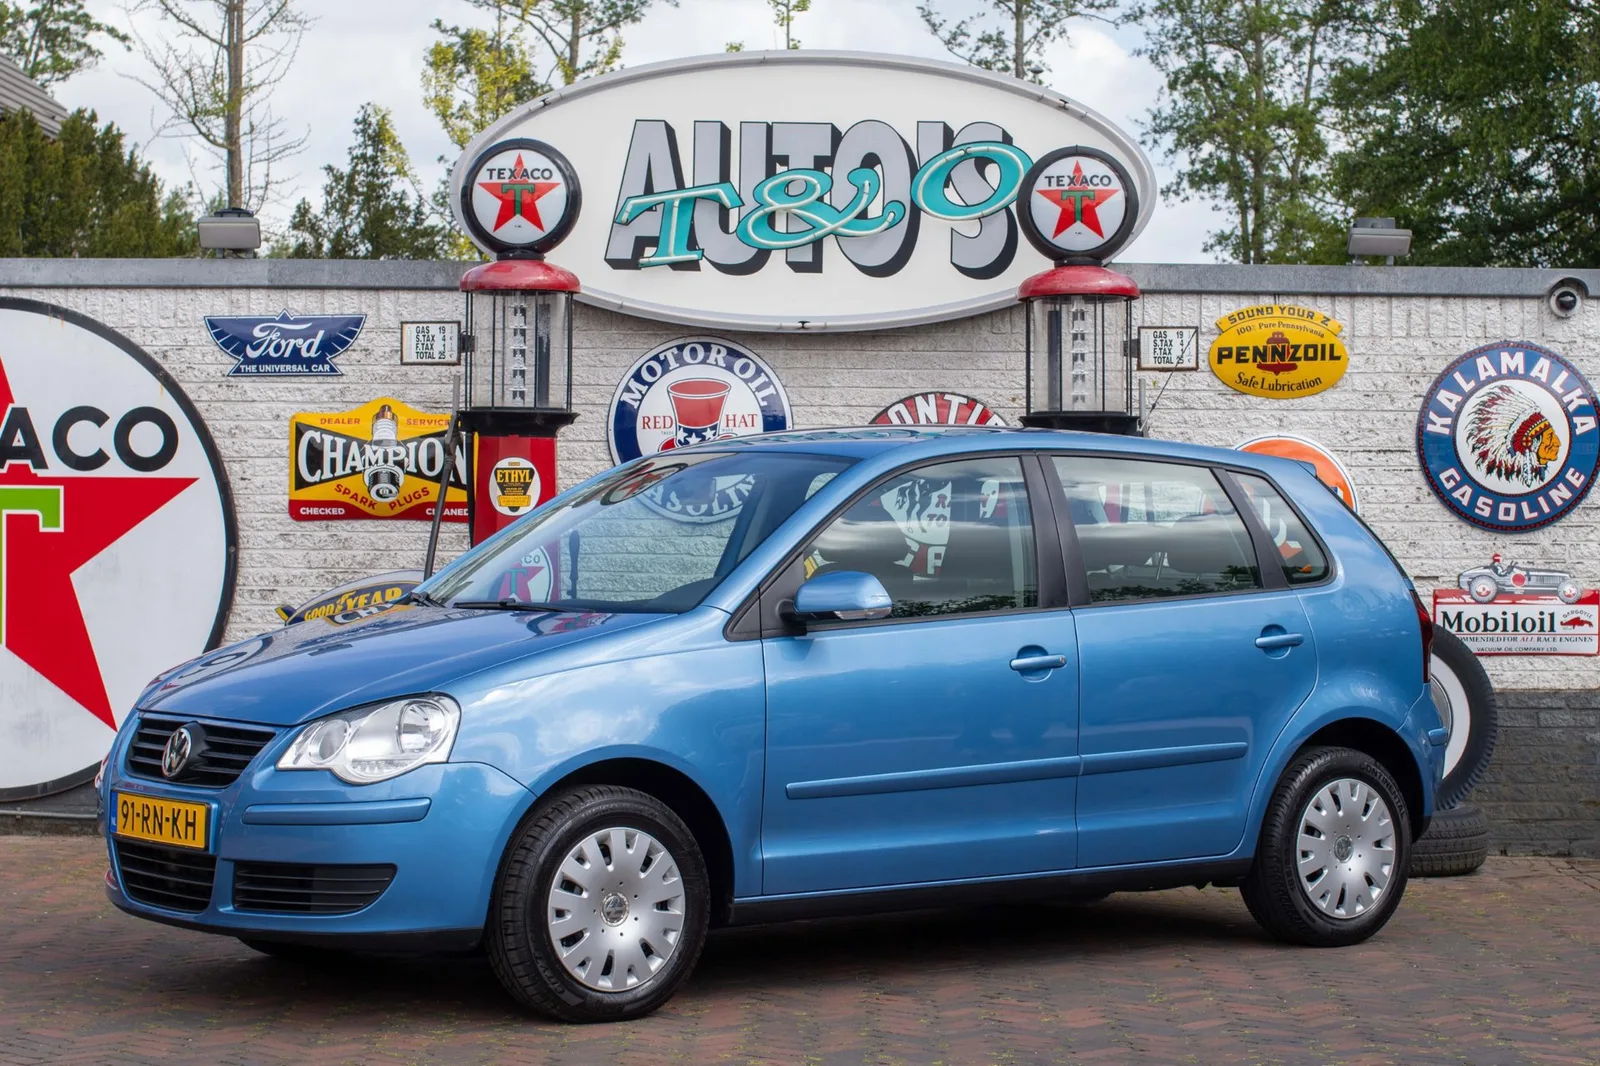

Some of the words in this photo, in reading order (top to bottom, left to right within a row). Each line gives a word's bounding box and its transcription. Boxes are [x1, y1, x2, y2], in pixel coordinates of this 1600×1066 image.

[486, 168, 553, 180] TEXACO
[1044, 174, 1112, 187] TEXACO
[604, 119, 1018, 280] AUTO'S
[1228, 306, 1274, 324] SOUND
[1278, 306, 1315, 320] YOUR
[1320, 316, 1332, 326] Z
[416, 326, 430, 334] GAS
[438, 326, 446, 334] 19
[416, 334, 436, 342] S.TAX
[1152, 330, 1168, 339] GAS
[1176, 330, 1184, 339] 19
[1258, 322, 1276, 330] Pure
[1278, 321, 1325, 339] Pennsylvania
[246, 322, 325, 358] Ford
[1153, 339, 1173, 347] S.TAX
[416, 351, 436, 360] TOTAL
[438, 351, 446, 360] 25
[1153, 356, 1174, 364] TOTAL
[1216, 344, 1342, 364] PENNZOIL
[240, 364, 258, 372] THE
[258, 364, 309, 372] UNIVERSAL
[312, 364, 330, 372] CAR
[620, 343, 728, 410] MOTOR
[733, 357, 778, 406] OIL
[1234, 372, 1258, 389] Safe
[1260, 376, 1322, 392] Lubrication
[1426, 352, 1597, 436] KALAMALKA
[642, 415, 674, 430] RED
[725, 414, 758, 428] HAT
[496, 469, 532, 483] ETHYL
[334, 484, 377, 510] SPARK
[389, 486, 431, 511] PLUGS
[1438, 467, 1586, 522] GASOLINE
[300, 507, 345, 515] CHECKED
[1441, 610, 1556, 633] Mobiloil
[1562, 610, 1594, 619] GARGOYLE
[121, 800, 196, 841] 91-RN-KH
